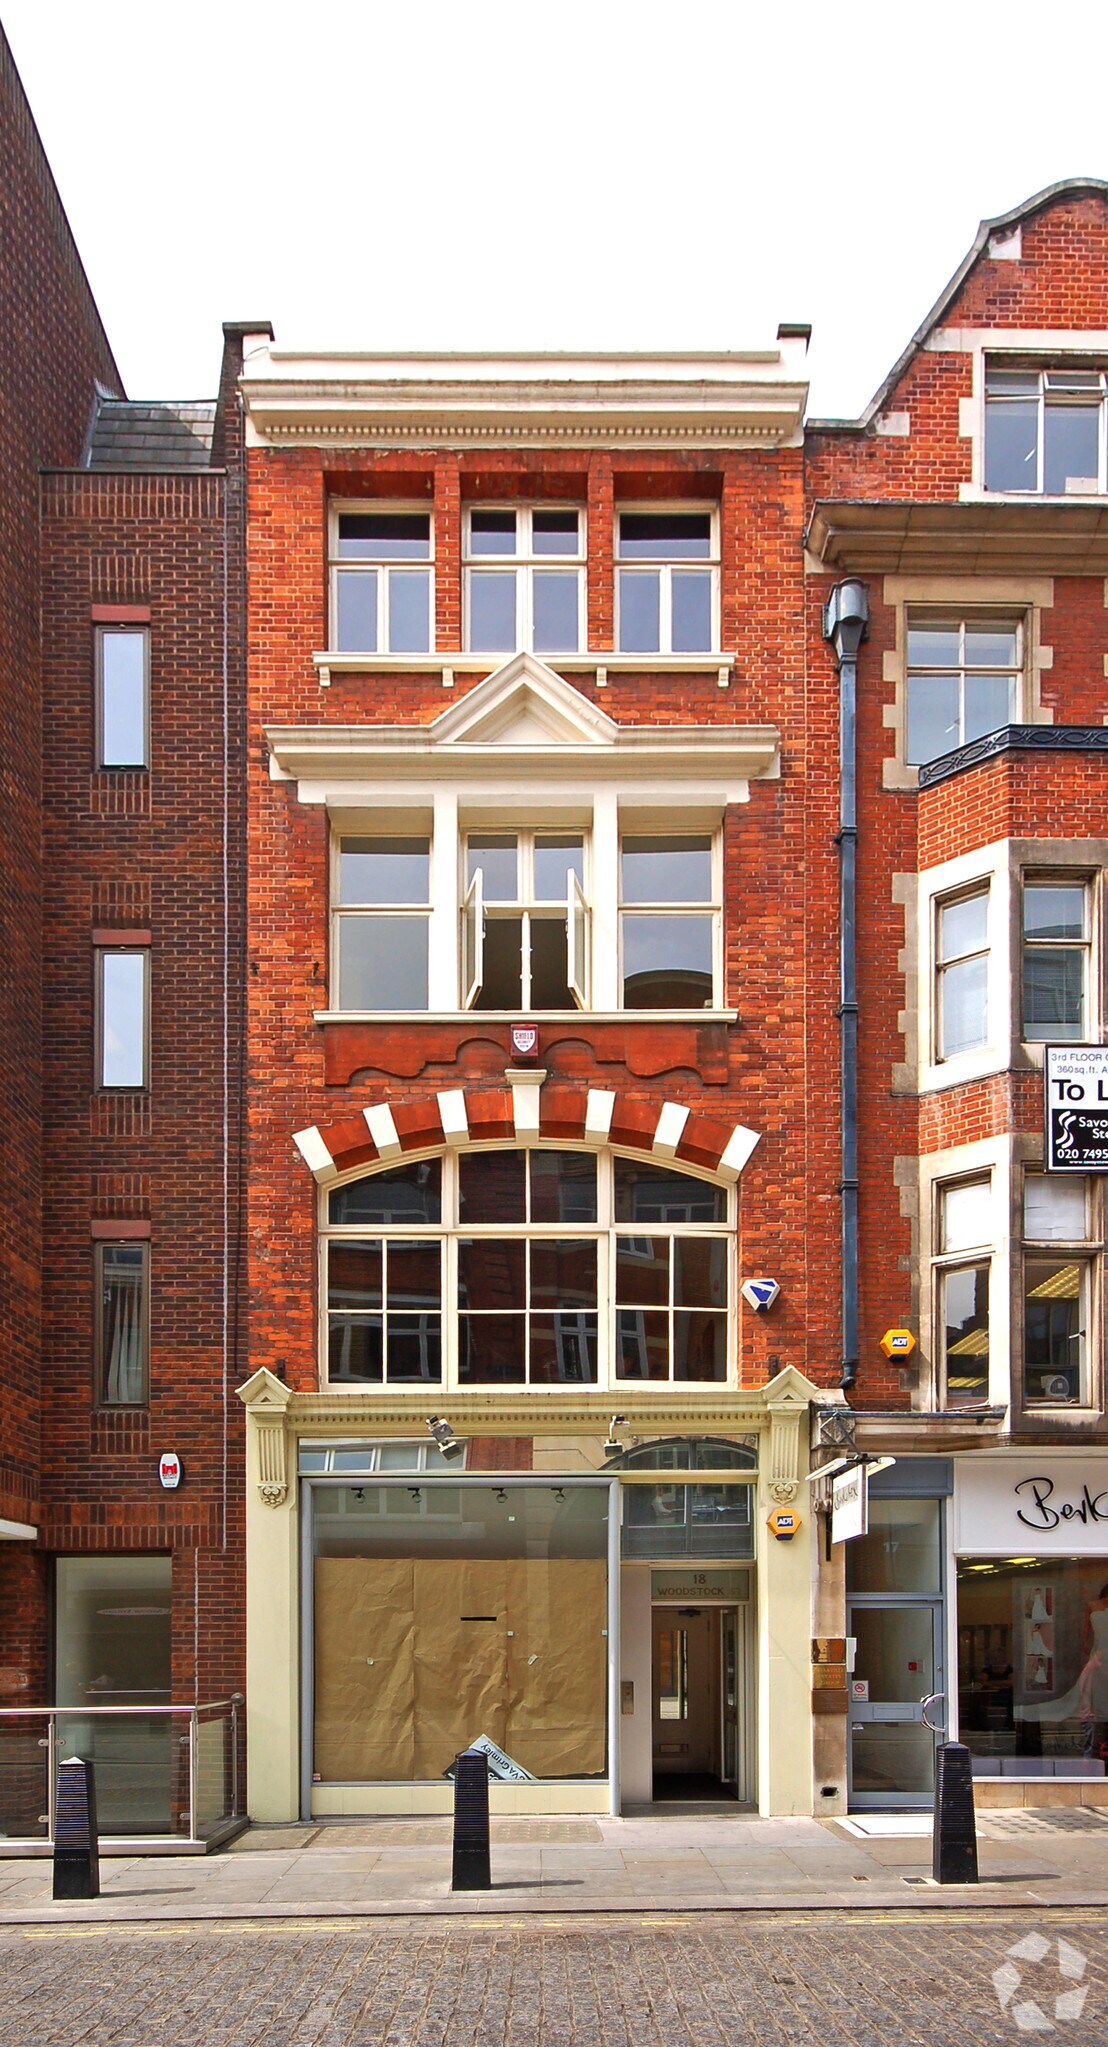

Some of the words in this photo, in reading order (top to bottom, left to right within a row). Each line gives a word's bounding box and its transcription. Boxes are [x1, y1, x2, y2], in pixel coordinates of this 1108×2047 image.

[1051, 1053, 1067, 1061] 3rd
[1070, 1053, 1102, 1061] FLOOR
[1051, 1079, 1085, 1101] To
[1057, 1149, 1079, 1159] 020
[892, 1337, 907, 1345] ADT
[777, 1517, 793, 1526] ADT
[883, 1541, 900, 1553] 17
[693, 1573, 706, 1584] 18
[657, 1587, 725, 1596] WOODSTOCK
[480, 1743, 510, 1770] Grimley
